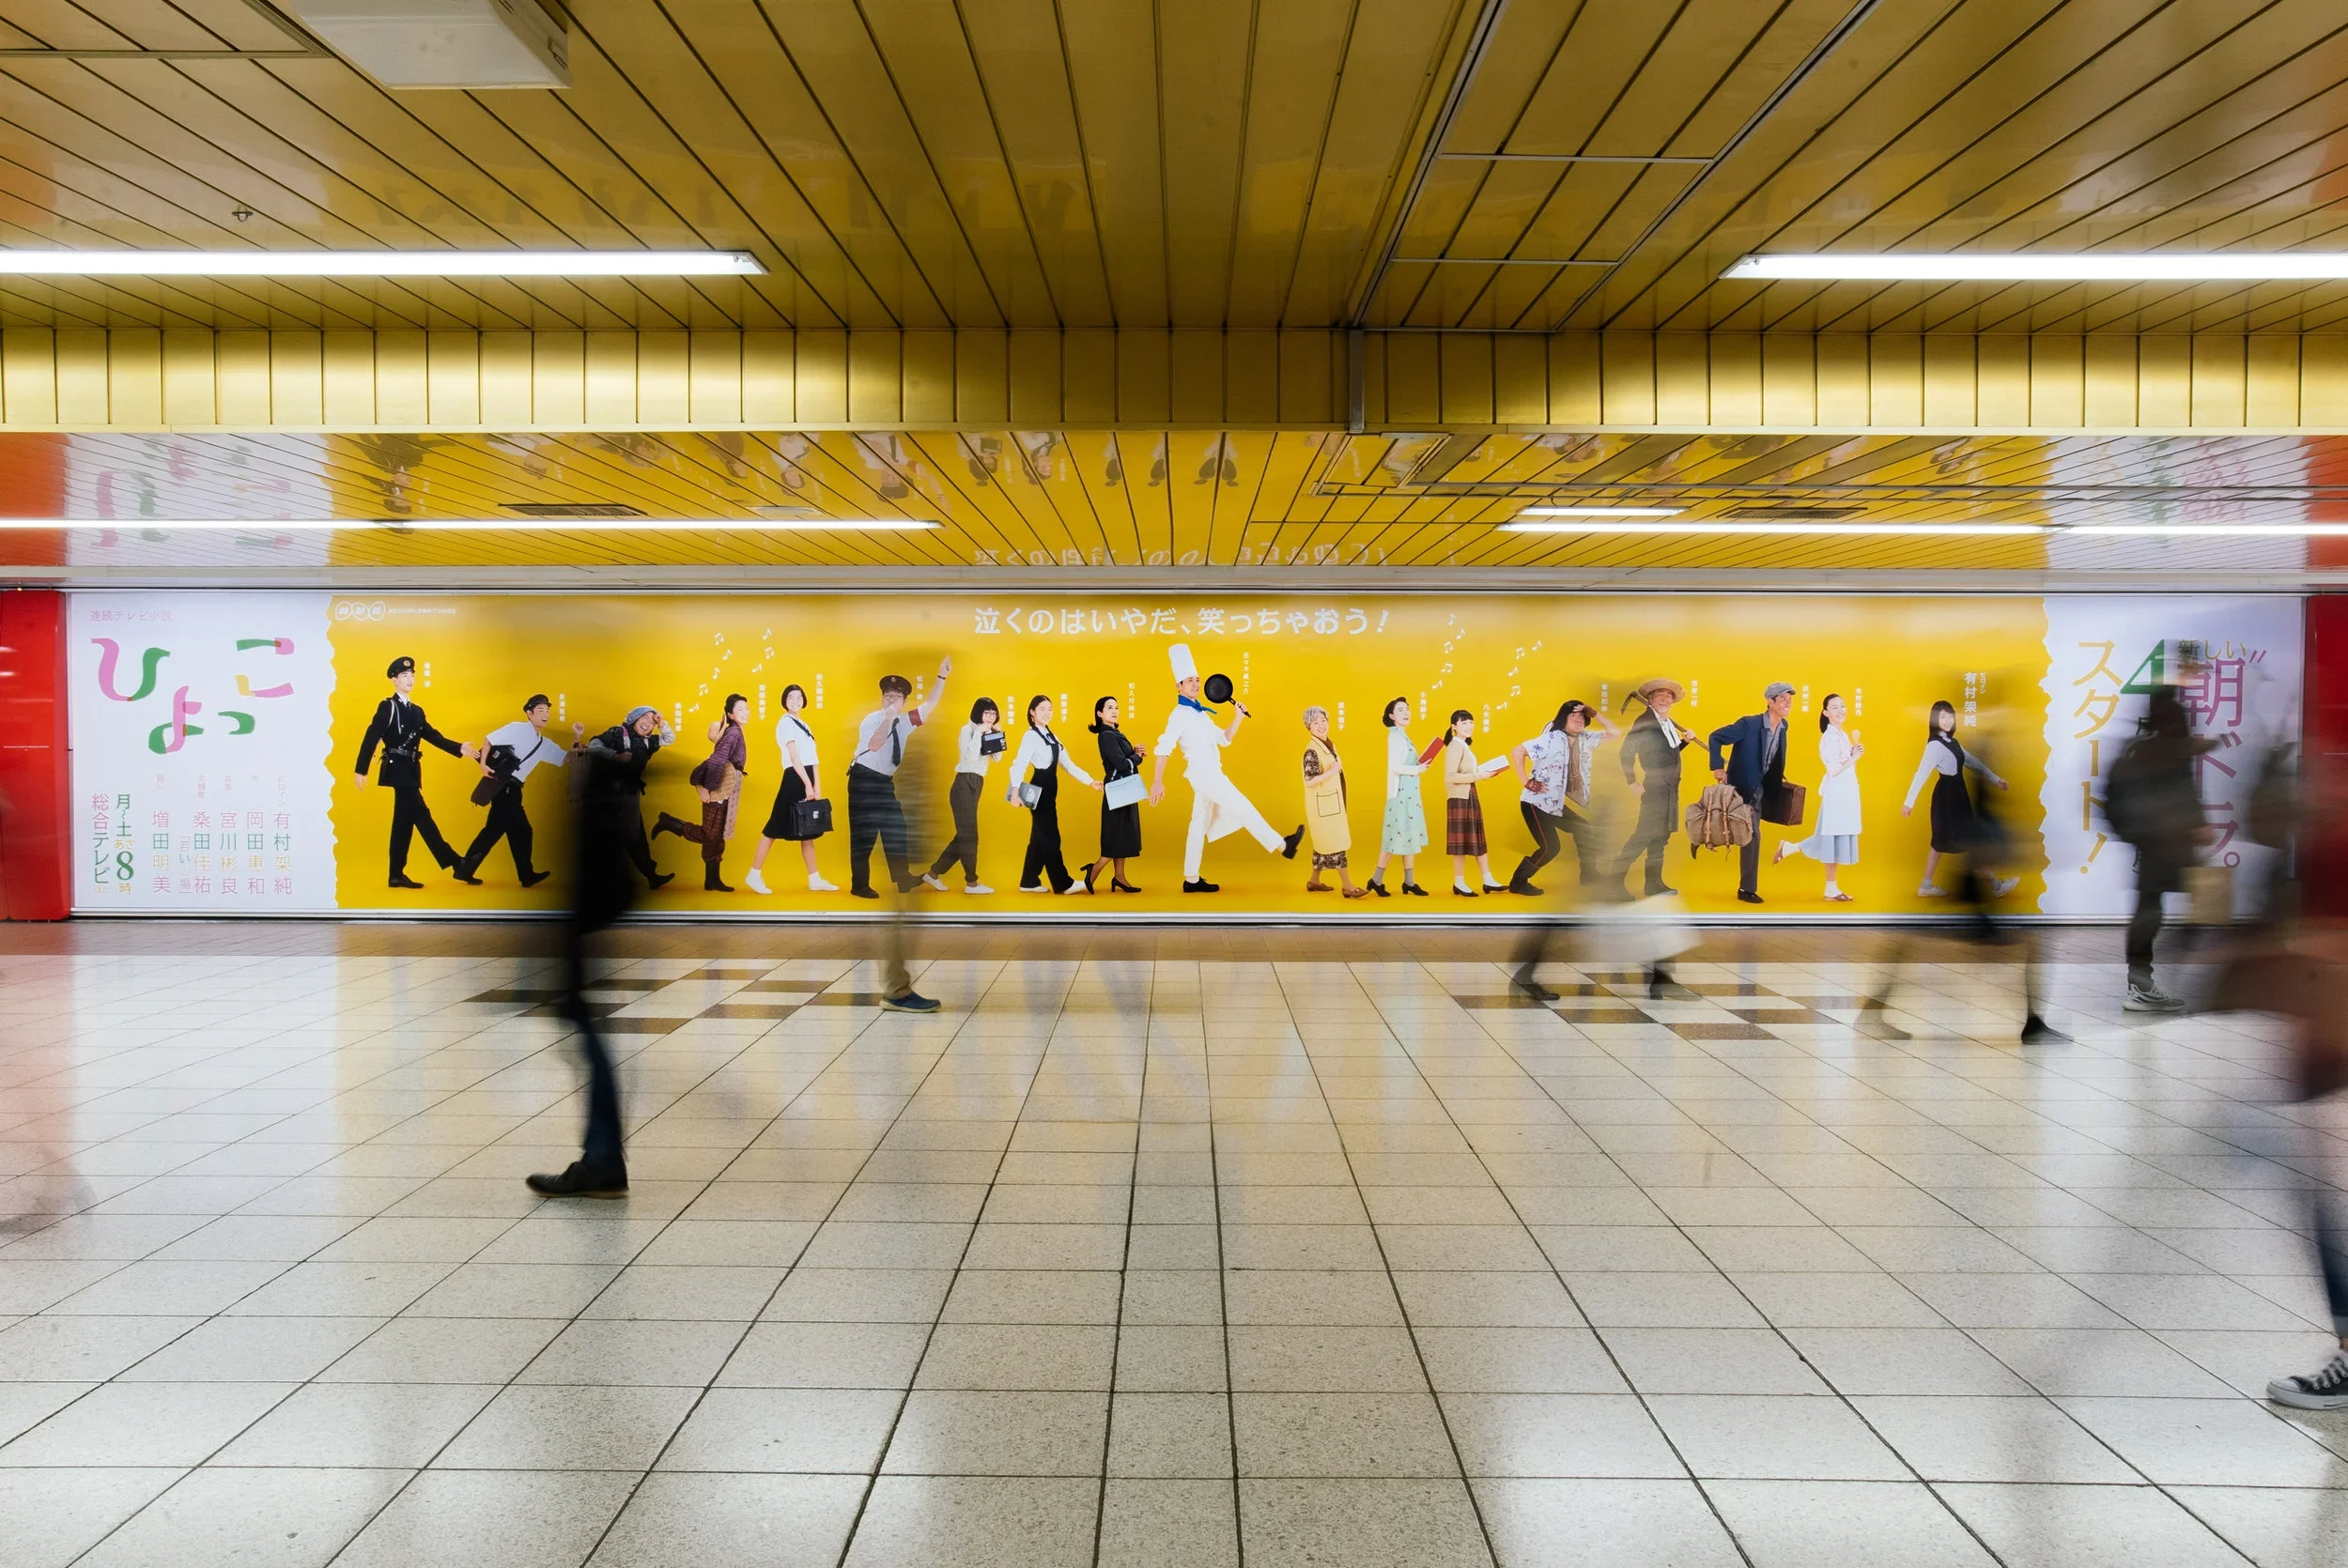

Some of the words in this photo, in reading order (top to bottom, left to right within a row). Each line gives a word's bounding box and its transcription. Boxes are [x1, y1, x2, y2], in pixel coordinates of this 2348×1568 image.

[90, 610, 173, 622] 連続テレビ小説
[91, 638, 295, 755] ひよっこ
[92, 793, 110, 884] 総合テレビ
[151, 811, 170, 894] 増田明美
[193, 811, 211, 894] 桑田佳祐
[220, 811, 238, 895] 宮川彬良
[273, 811, 293, 895] 有村架純
